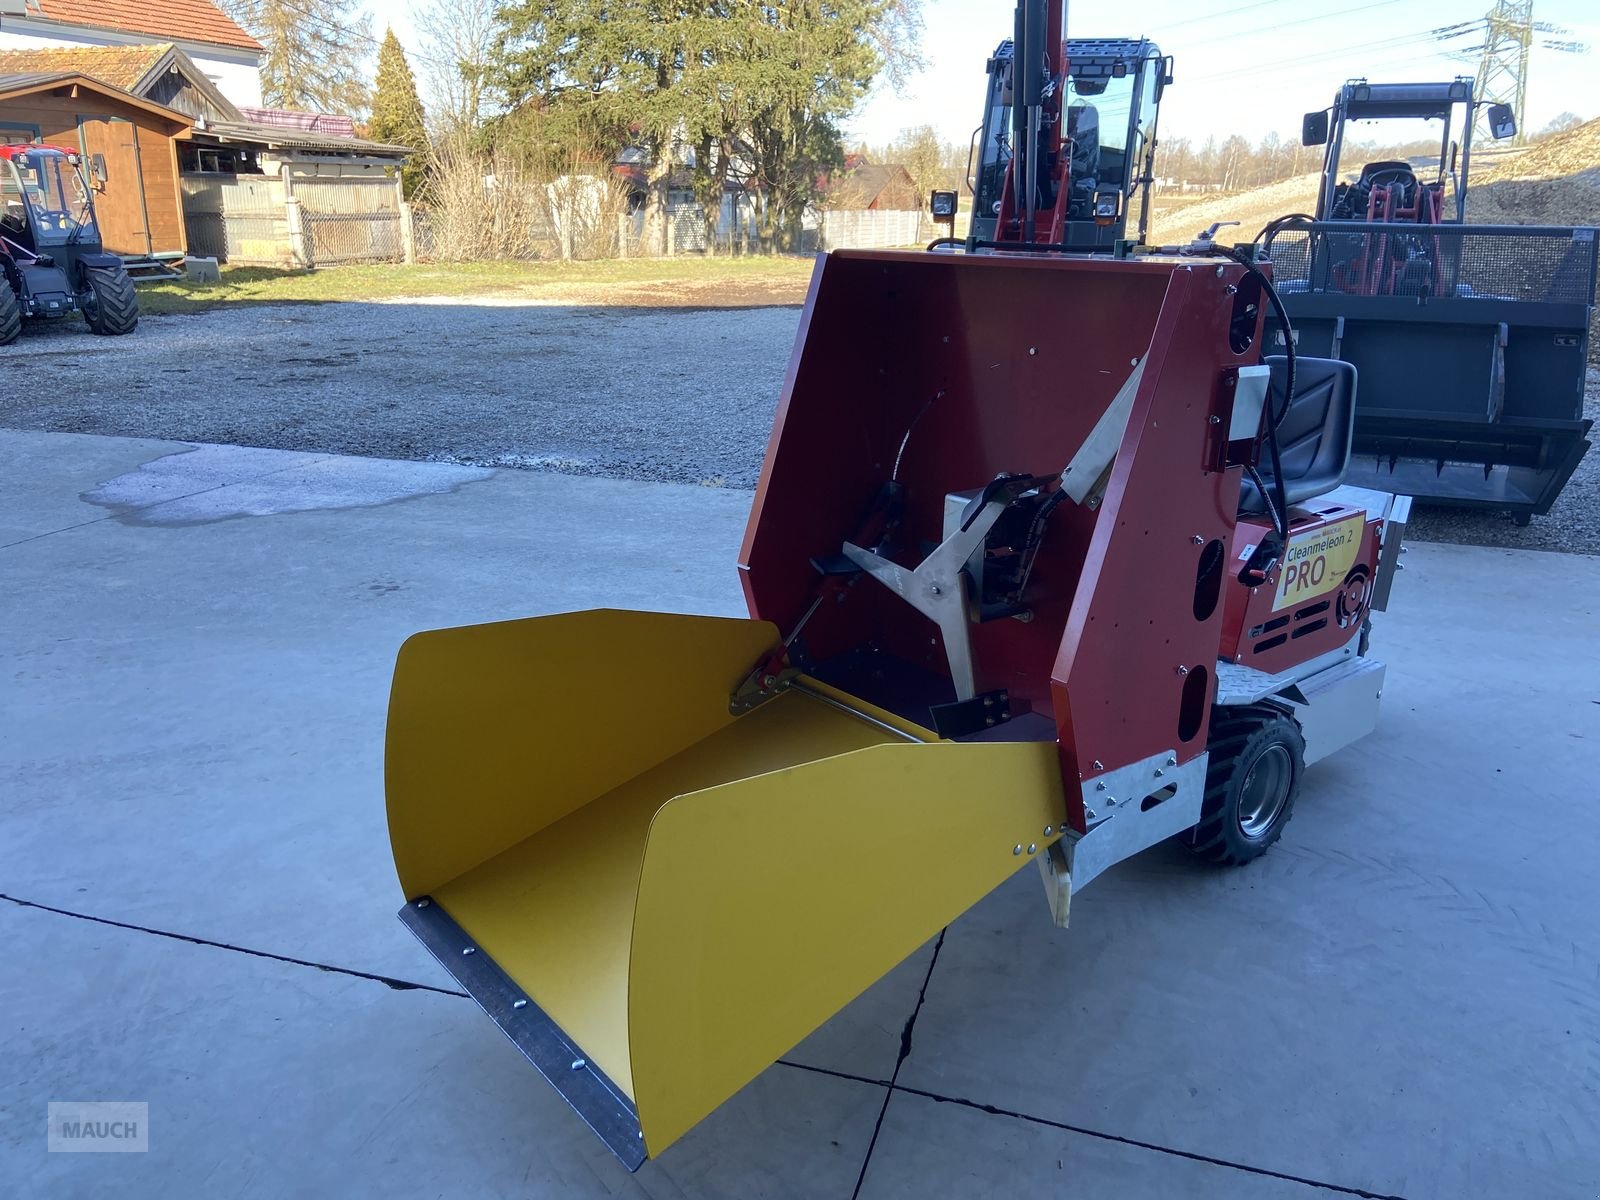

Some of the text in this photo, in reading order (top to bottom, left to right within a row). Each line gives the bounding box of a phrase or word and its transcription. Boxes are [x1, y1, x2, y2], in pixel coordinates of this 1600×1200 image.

[1288, 529, 1353, 561] Cleanmeleon 2
[1283, 555, 1325, 596] PRO
